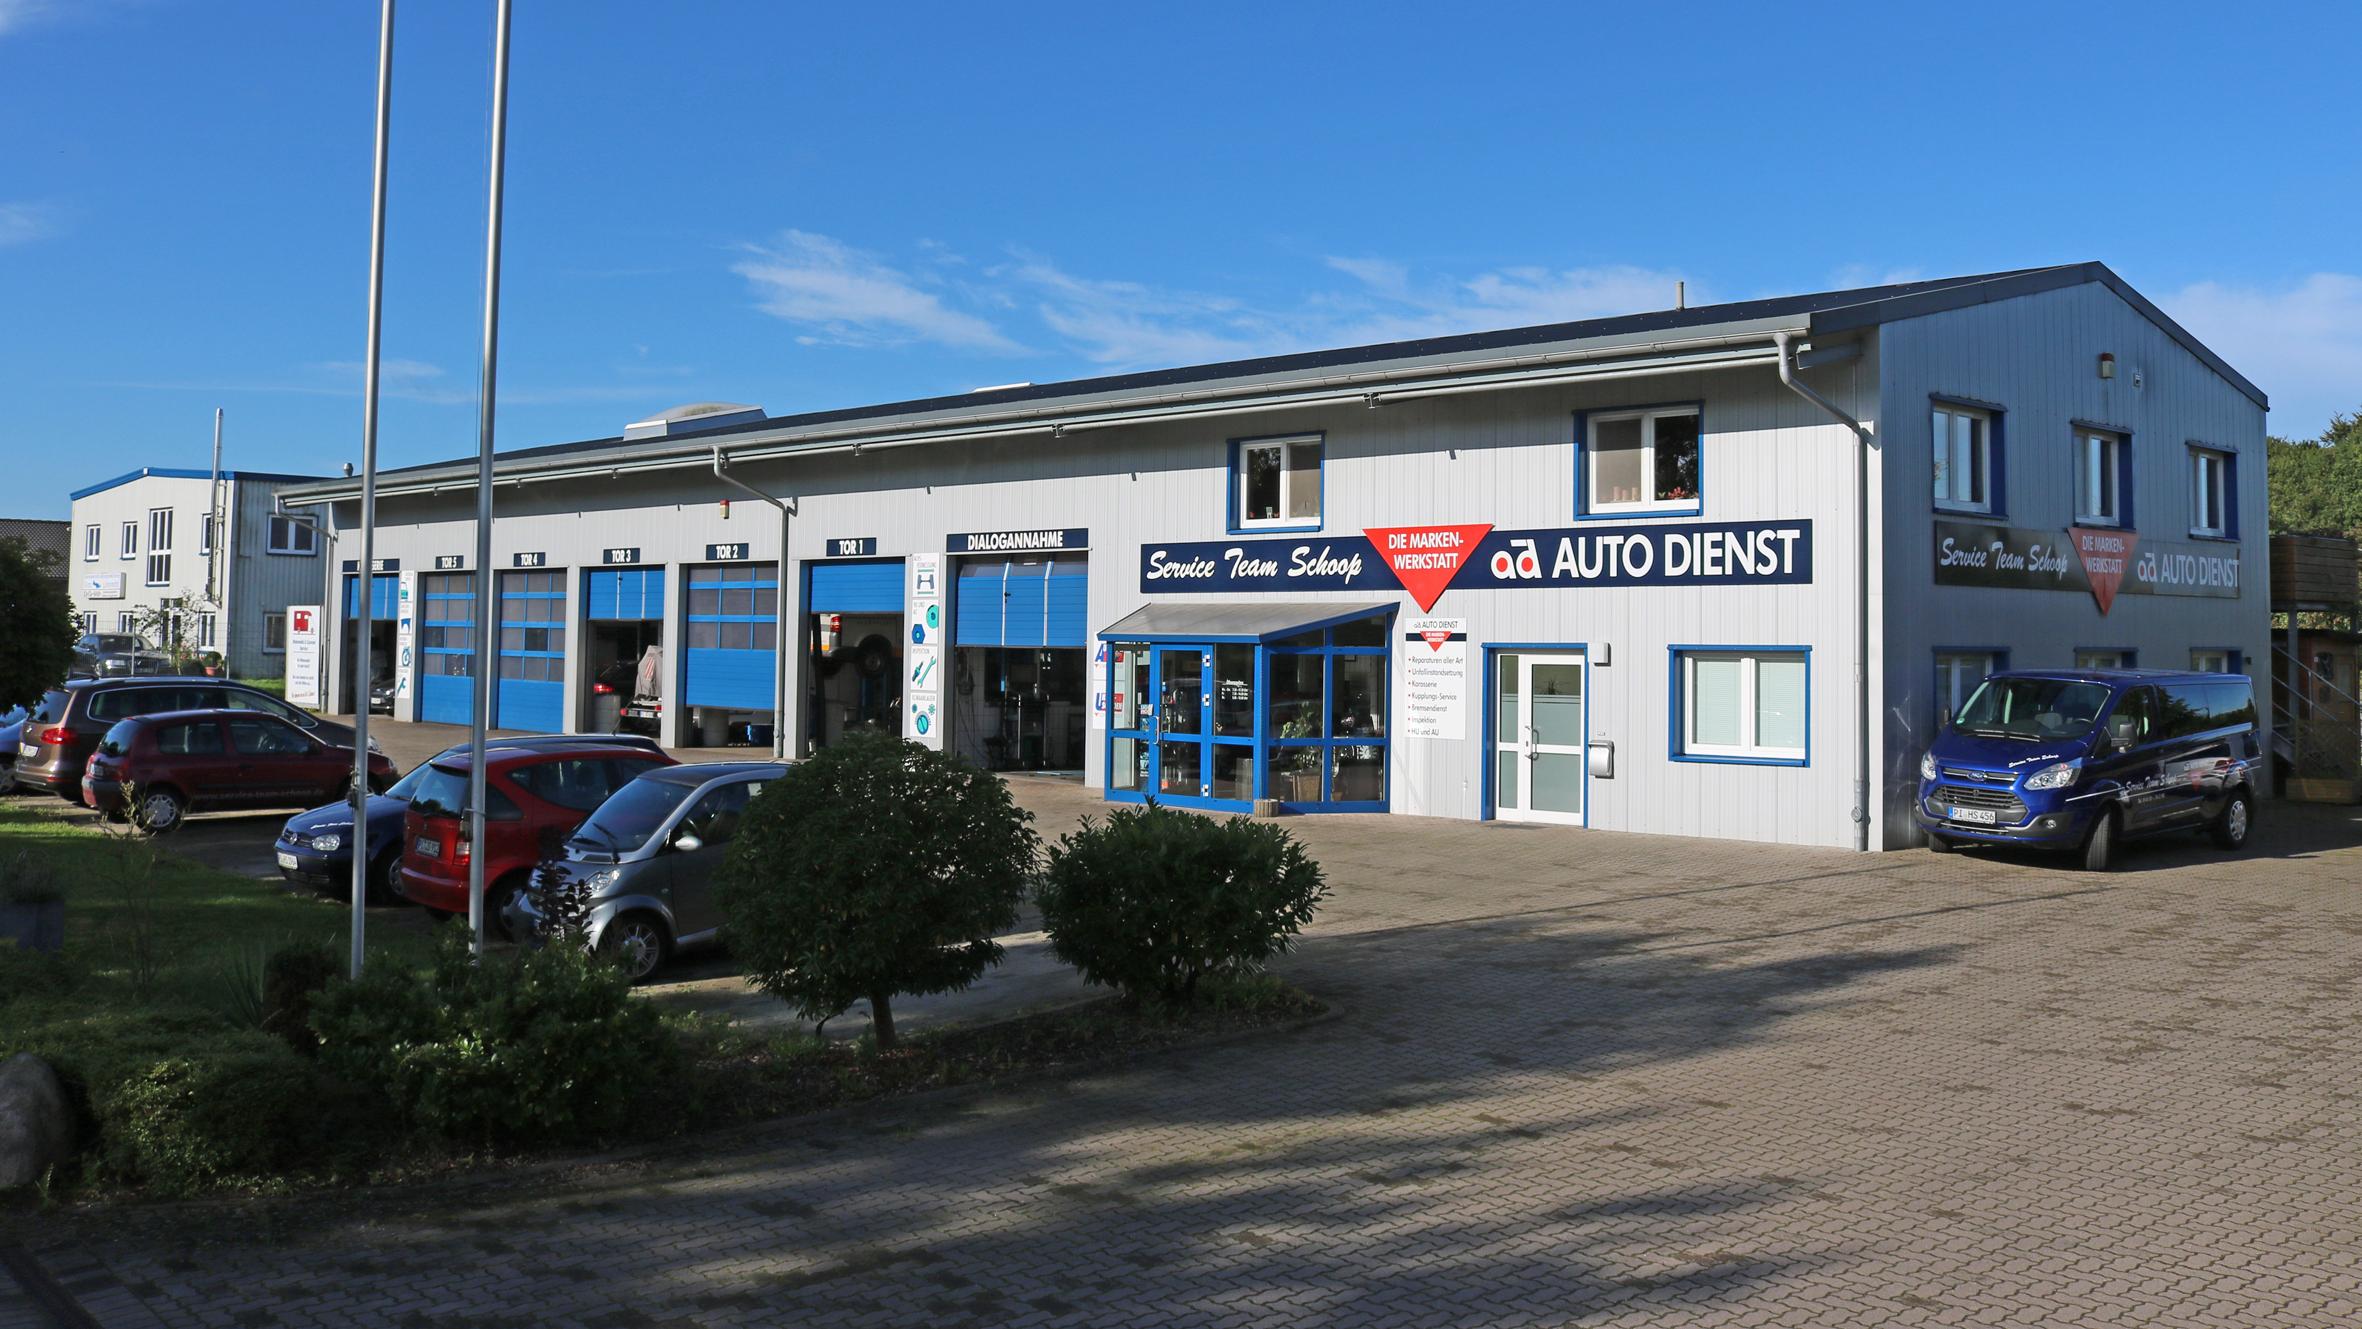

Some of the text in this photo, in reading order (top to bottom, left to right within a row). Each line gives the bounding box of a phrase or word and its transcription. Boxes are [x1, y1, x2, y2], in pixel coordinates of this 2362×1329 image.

[839, 539, 863, 555] TOR 1
[967, 531, 1063, 550] DIALOGANNAHME
[1388, 531, 1464, 549] DIE MARKEN-
[2082, 535, 2125, 553] DIE MARKEN-
[520, 553, 538, 566] TOR 4
[611, 549, 632, 563] TOR 3
[715, 545, 738, 559] TOR 2
[1551, 529, 1801, 579] AUTO DIENST
[1940, 537, 2068, 581] Service Team Schoop
[441, 557, 453, 569] TOR
[1146, 545, 1363, 585] Service Team Schoop
[1393, 553, 1458, 570] WERKSTATT
[2085, 557, 2122, 574] WERKSTATT
[2161, 554, 2240, 587] AUTO DIENST
[1422, 620, 1438, 628] AUTO
[1439, 620, 1458, 629] DIENST
[1967, 810, 1978, 820] HS
[1979, 812, 1995, 821] 456
